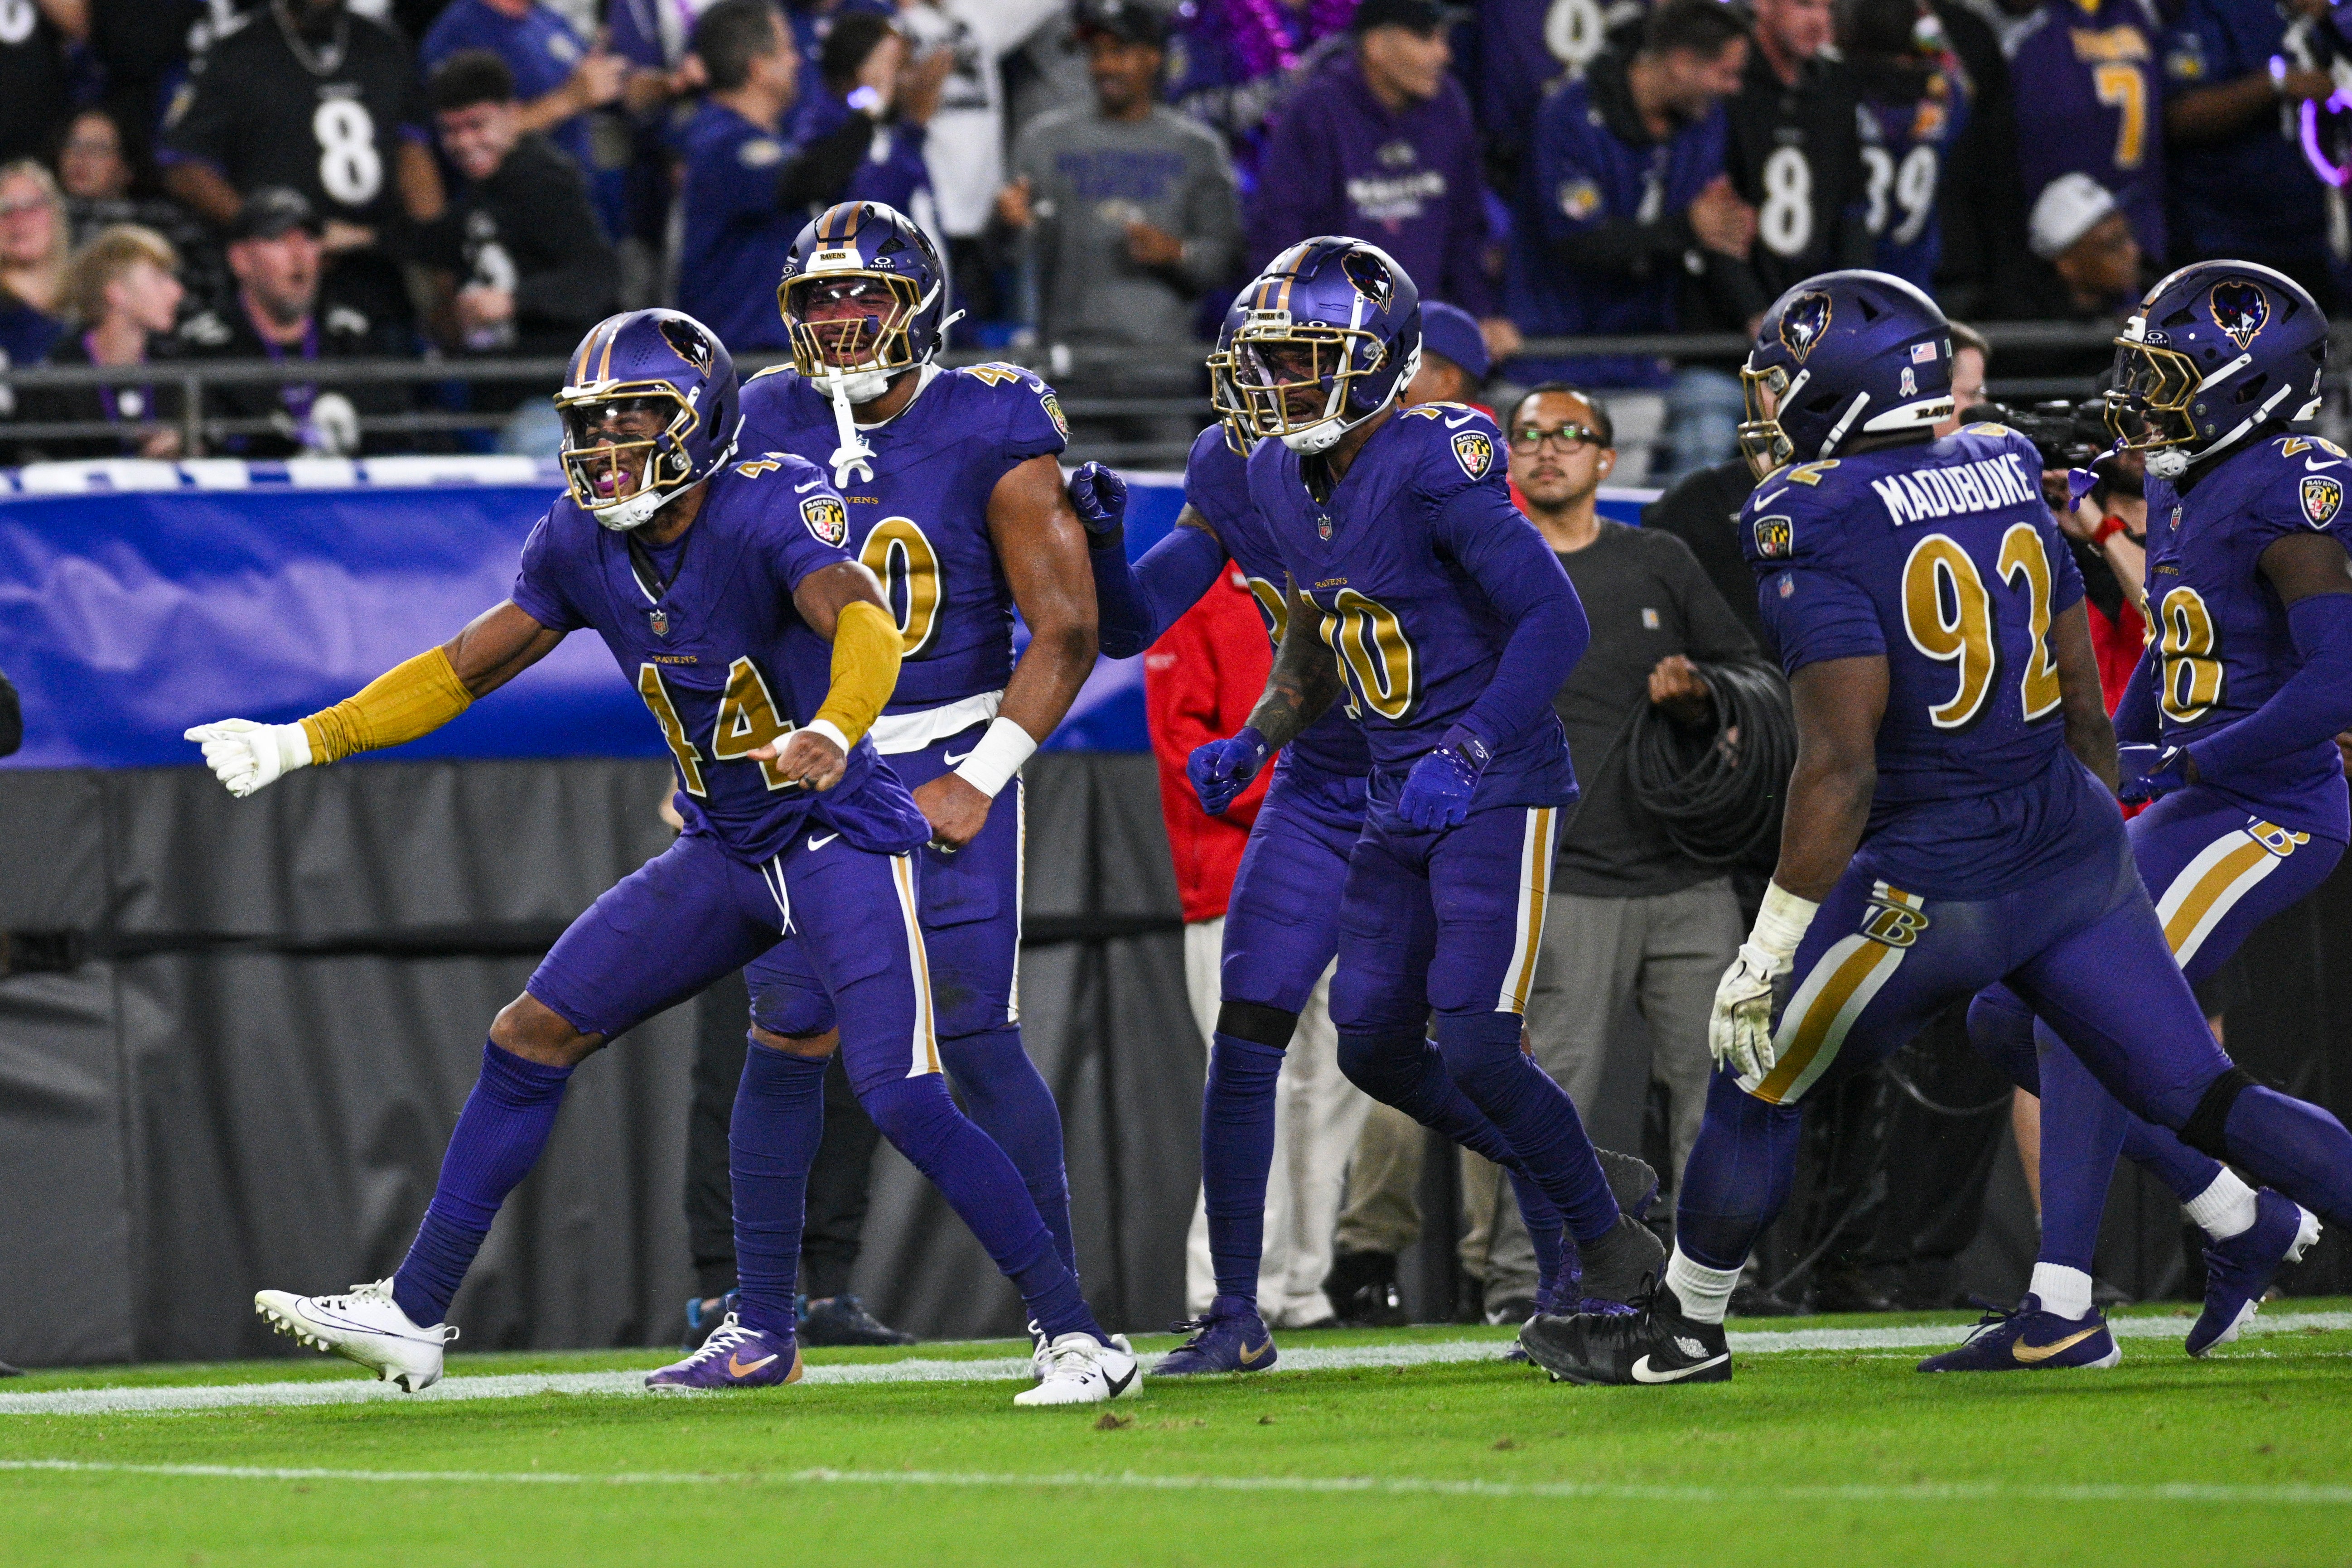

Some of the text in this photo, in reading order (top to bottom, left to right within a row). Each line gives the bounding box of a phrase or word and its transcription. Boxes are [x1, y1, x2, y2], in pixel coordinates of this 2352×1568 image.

[2092, 63, 2148, 169] 7
[313, 97, 383, 206] 8
[1760, 145, 1812, 256] 8
[820, 252, 846, 261] RAVENS
[1455, 434, 1486, 443] RAVENS
[805, 499, 839, 510] RAVENS
[1871, 453, 2036, 526] MADUBUIKE
[2305, 480, 2338, 490] RAVENS
[1315, 577, 1347, 589] RAVENS
[1902, 522, 2062, 728] 92
[652, 655, 698, 663] RAVENS
[2140, 586, 2223, 729] 8
[638, 655, 799, 798] 44
[1864, 899, 1929, 946] B
